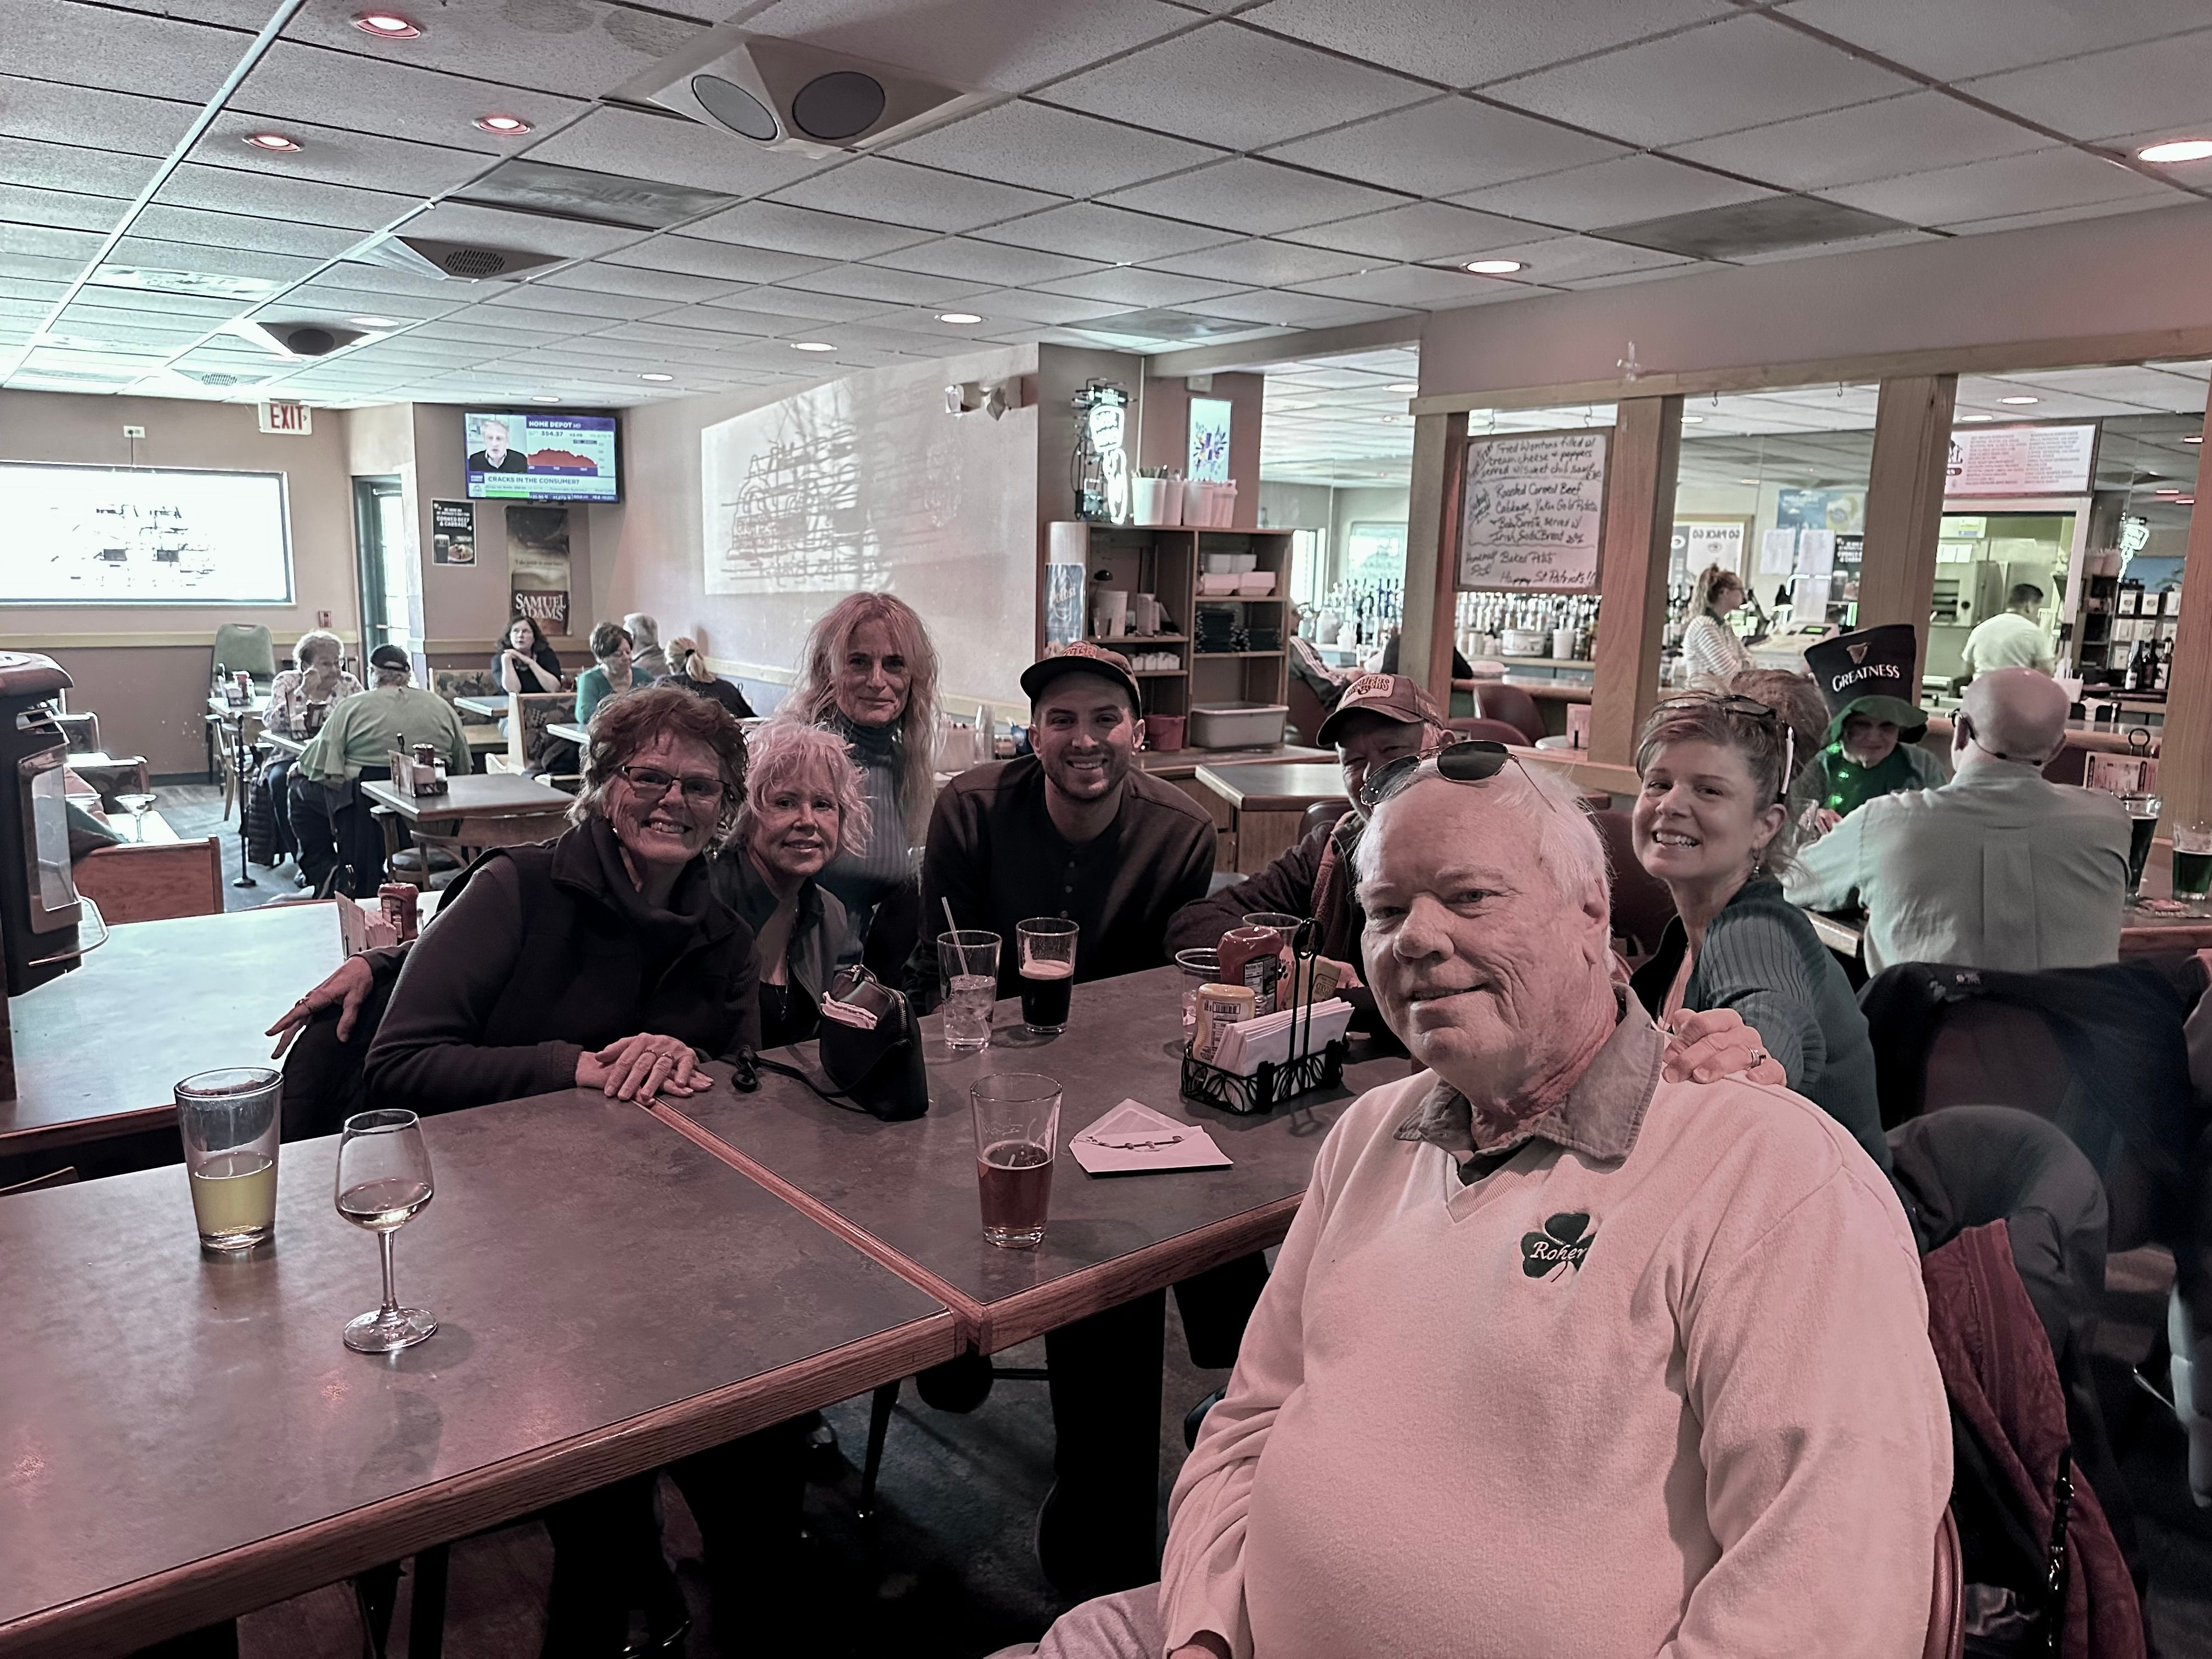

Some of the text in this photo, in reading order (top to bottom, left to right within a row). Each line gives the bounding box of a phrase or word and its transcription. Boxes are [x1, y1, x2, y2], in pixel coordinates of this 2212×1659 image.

[270, 403, 304, 431] EXIT
[516, 593, 567, 610] SAMUEL
[521, 606, 564, 622] ADAMS
[1832, 664, 1900, 692] GREATNESS
